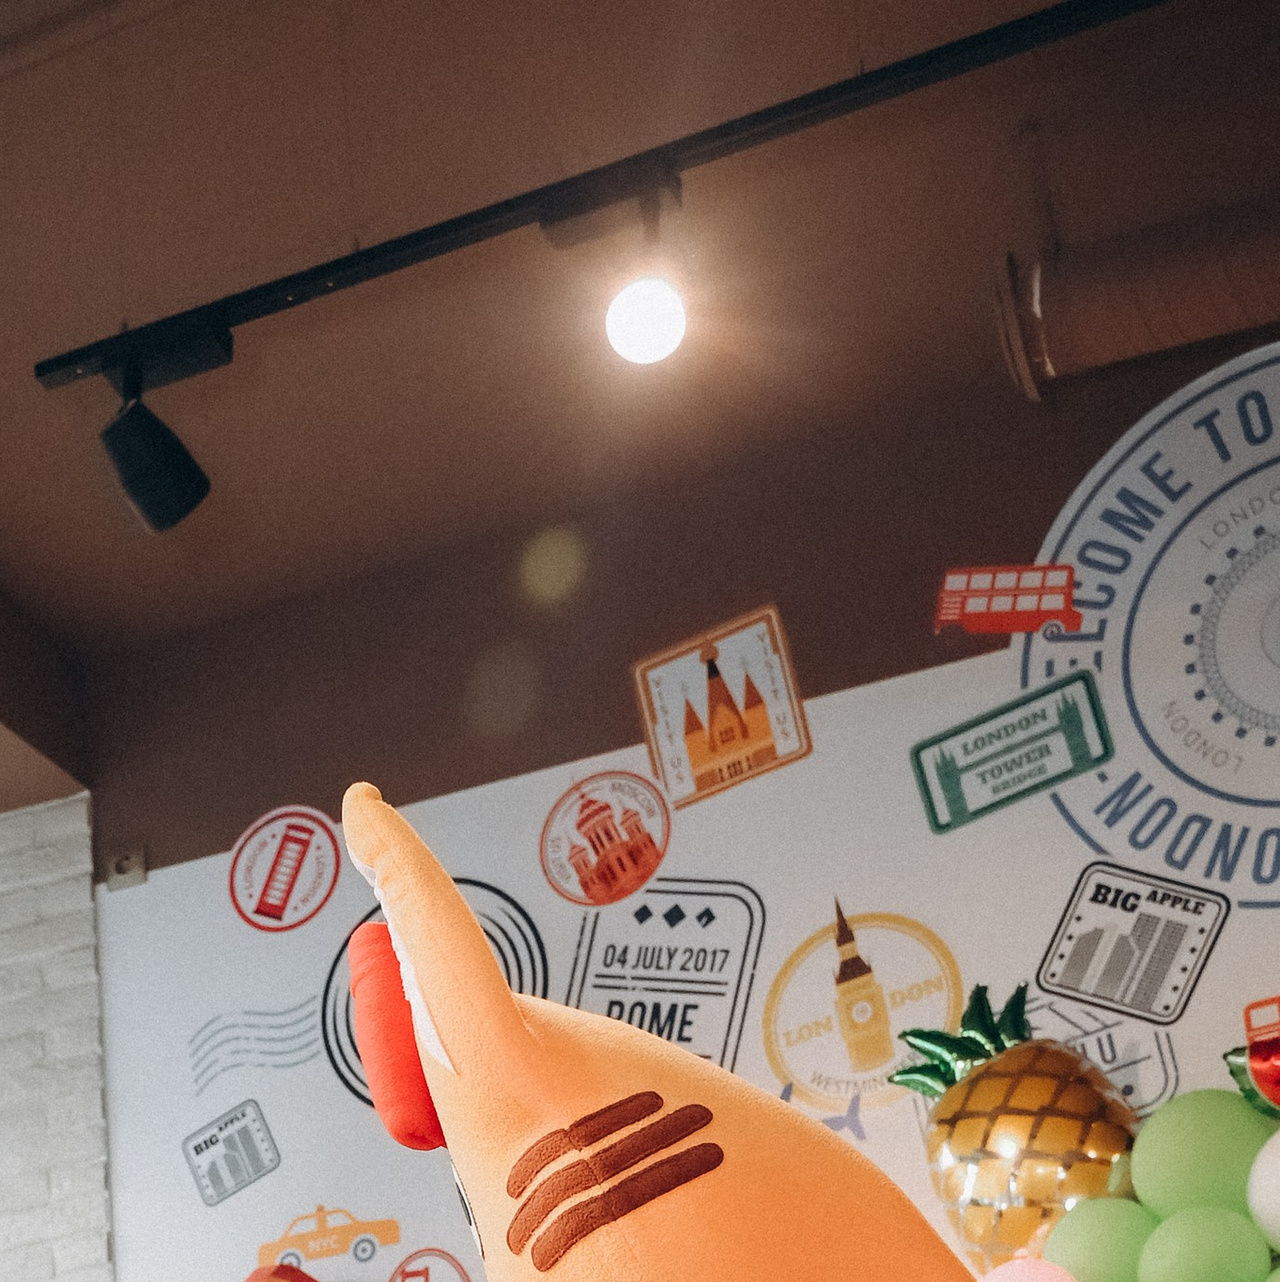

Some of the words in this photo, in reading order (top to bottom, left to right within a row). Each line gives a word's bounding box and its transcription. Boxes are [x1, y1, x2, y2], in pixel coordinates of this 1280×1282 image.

[1193, 389, 1274, 463] TO
[961, 708, 1048, 757] LONDON
[975, 743, 1053, 785] TOWER
[1094, 772, 1280, 886] ONDON
[1089, 883, 1141, 914] BIG
[1146, 889, 1206, 915] APPLE
[602, 944, 629, 969] 04
[631, 946, 678, 971] JULY
[679, 948, 731, 973] 2017
[193, 1135, 219, 1155] BIG
